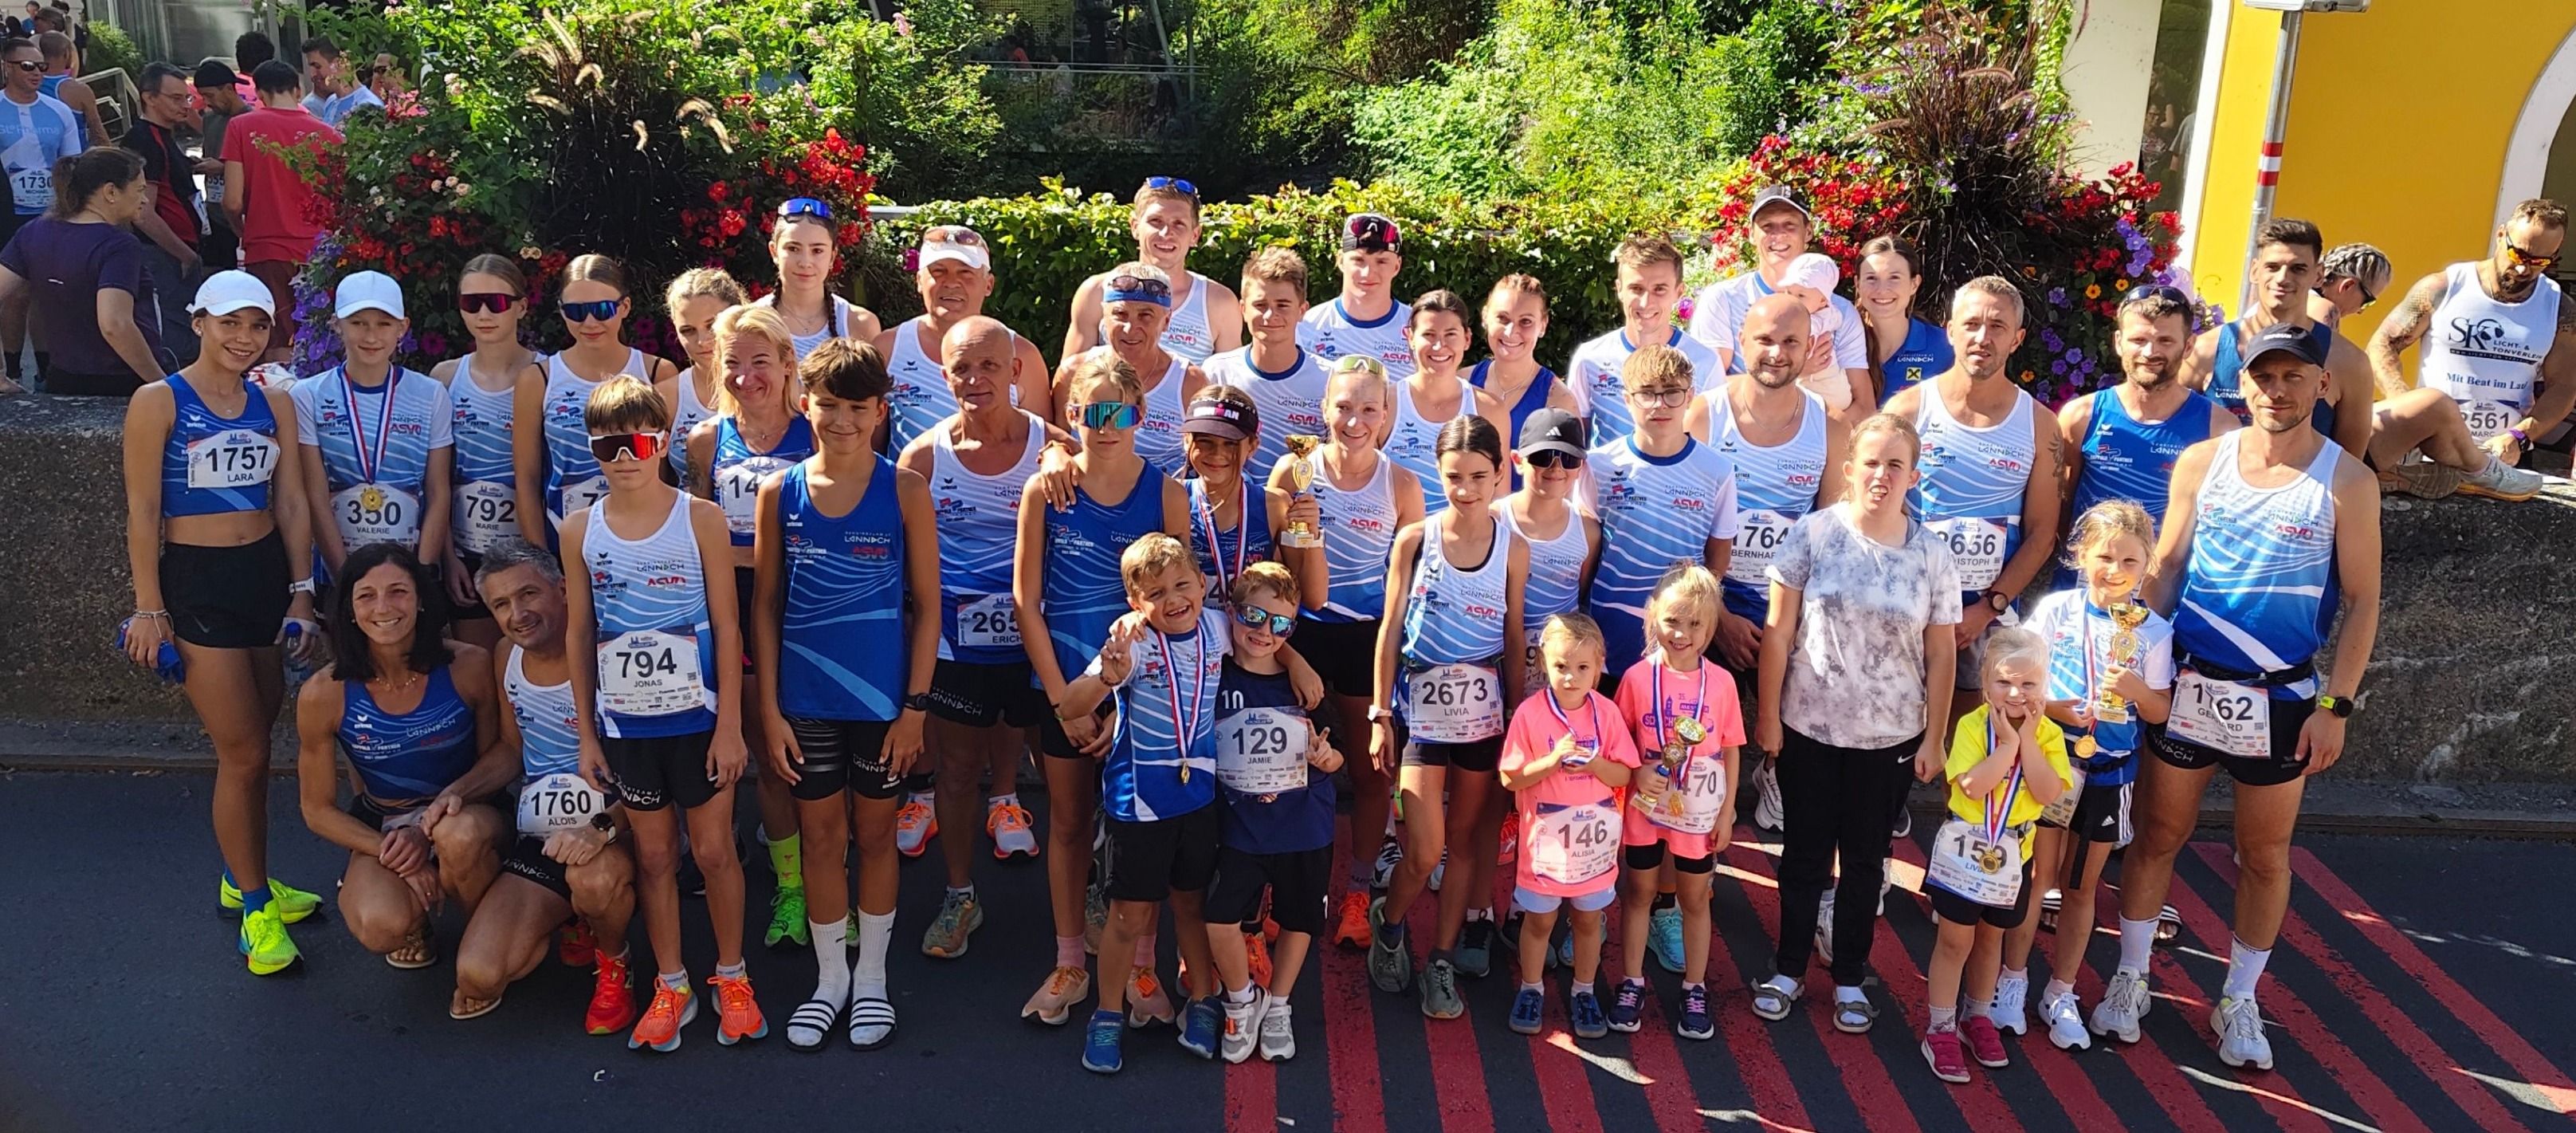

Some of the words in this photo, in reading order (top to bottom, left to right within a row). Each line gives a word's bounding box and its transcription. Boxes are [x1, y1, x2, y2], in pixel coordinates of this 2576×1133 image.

[18, 175, 53, 189] 1730
[2447, 372, 2464, 384] Mit
[2467, 376, 2491, 388] Beat
[2493, 380, 2507, 388] im
[205, 445, 269, 472] 1757
[227, 473, 254, 483] LARA
[465, 494, 515, 523] 792
[356, 526, 391, 535] VALERIE
[476, 522, 500, 531] MARIE
[1957, 557, 1991, 566] ISTOPH
[992, 635, 1021, 643] ERICH
[615, 647, 677, 679] 794
[633, 679, 663, 688] JONAS
[1421, 677, 1489, 706] 2673
[1221, 690, 1245, 709] 10
[1444, 707, 1470, 717] LIVIA
[1231, 726, 1288, 755] 129
[530, 789, 592, 816] 1760
[548, 816, 579, 827] ALOIS
[1557, 820, 1608, 850] 146
[1572, 849, 1596, 859] ALISIA
